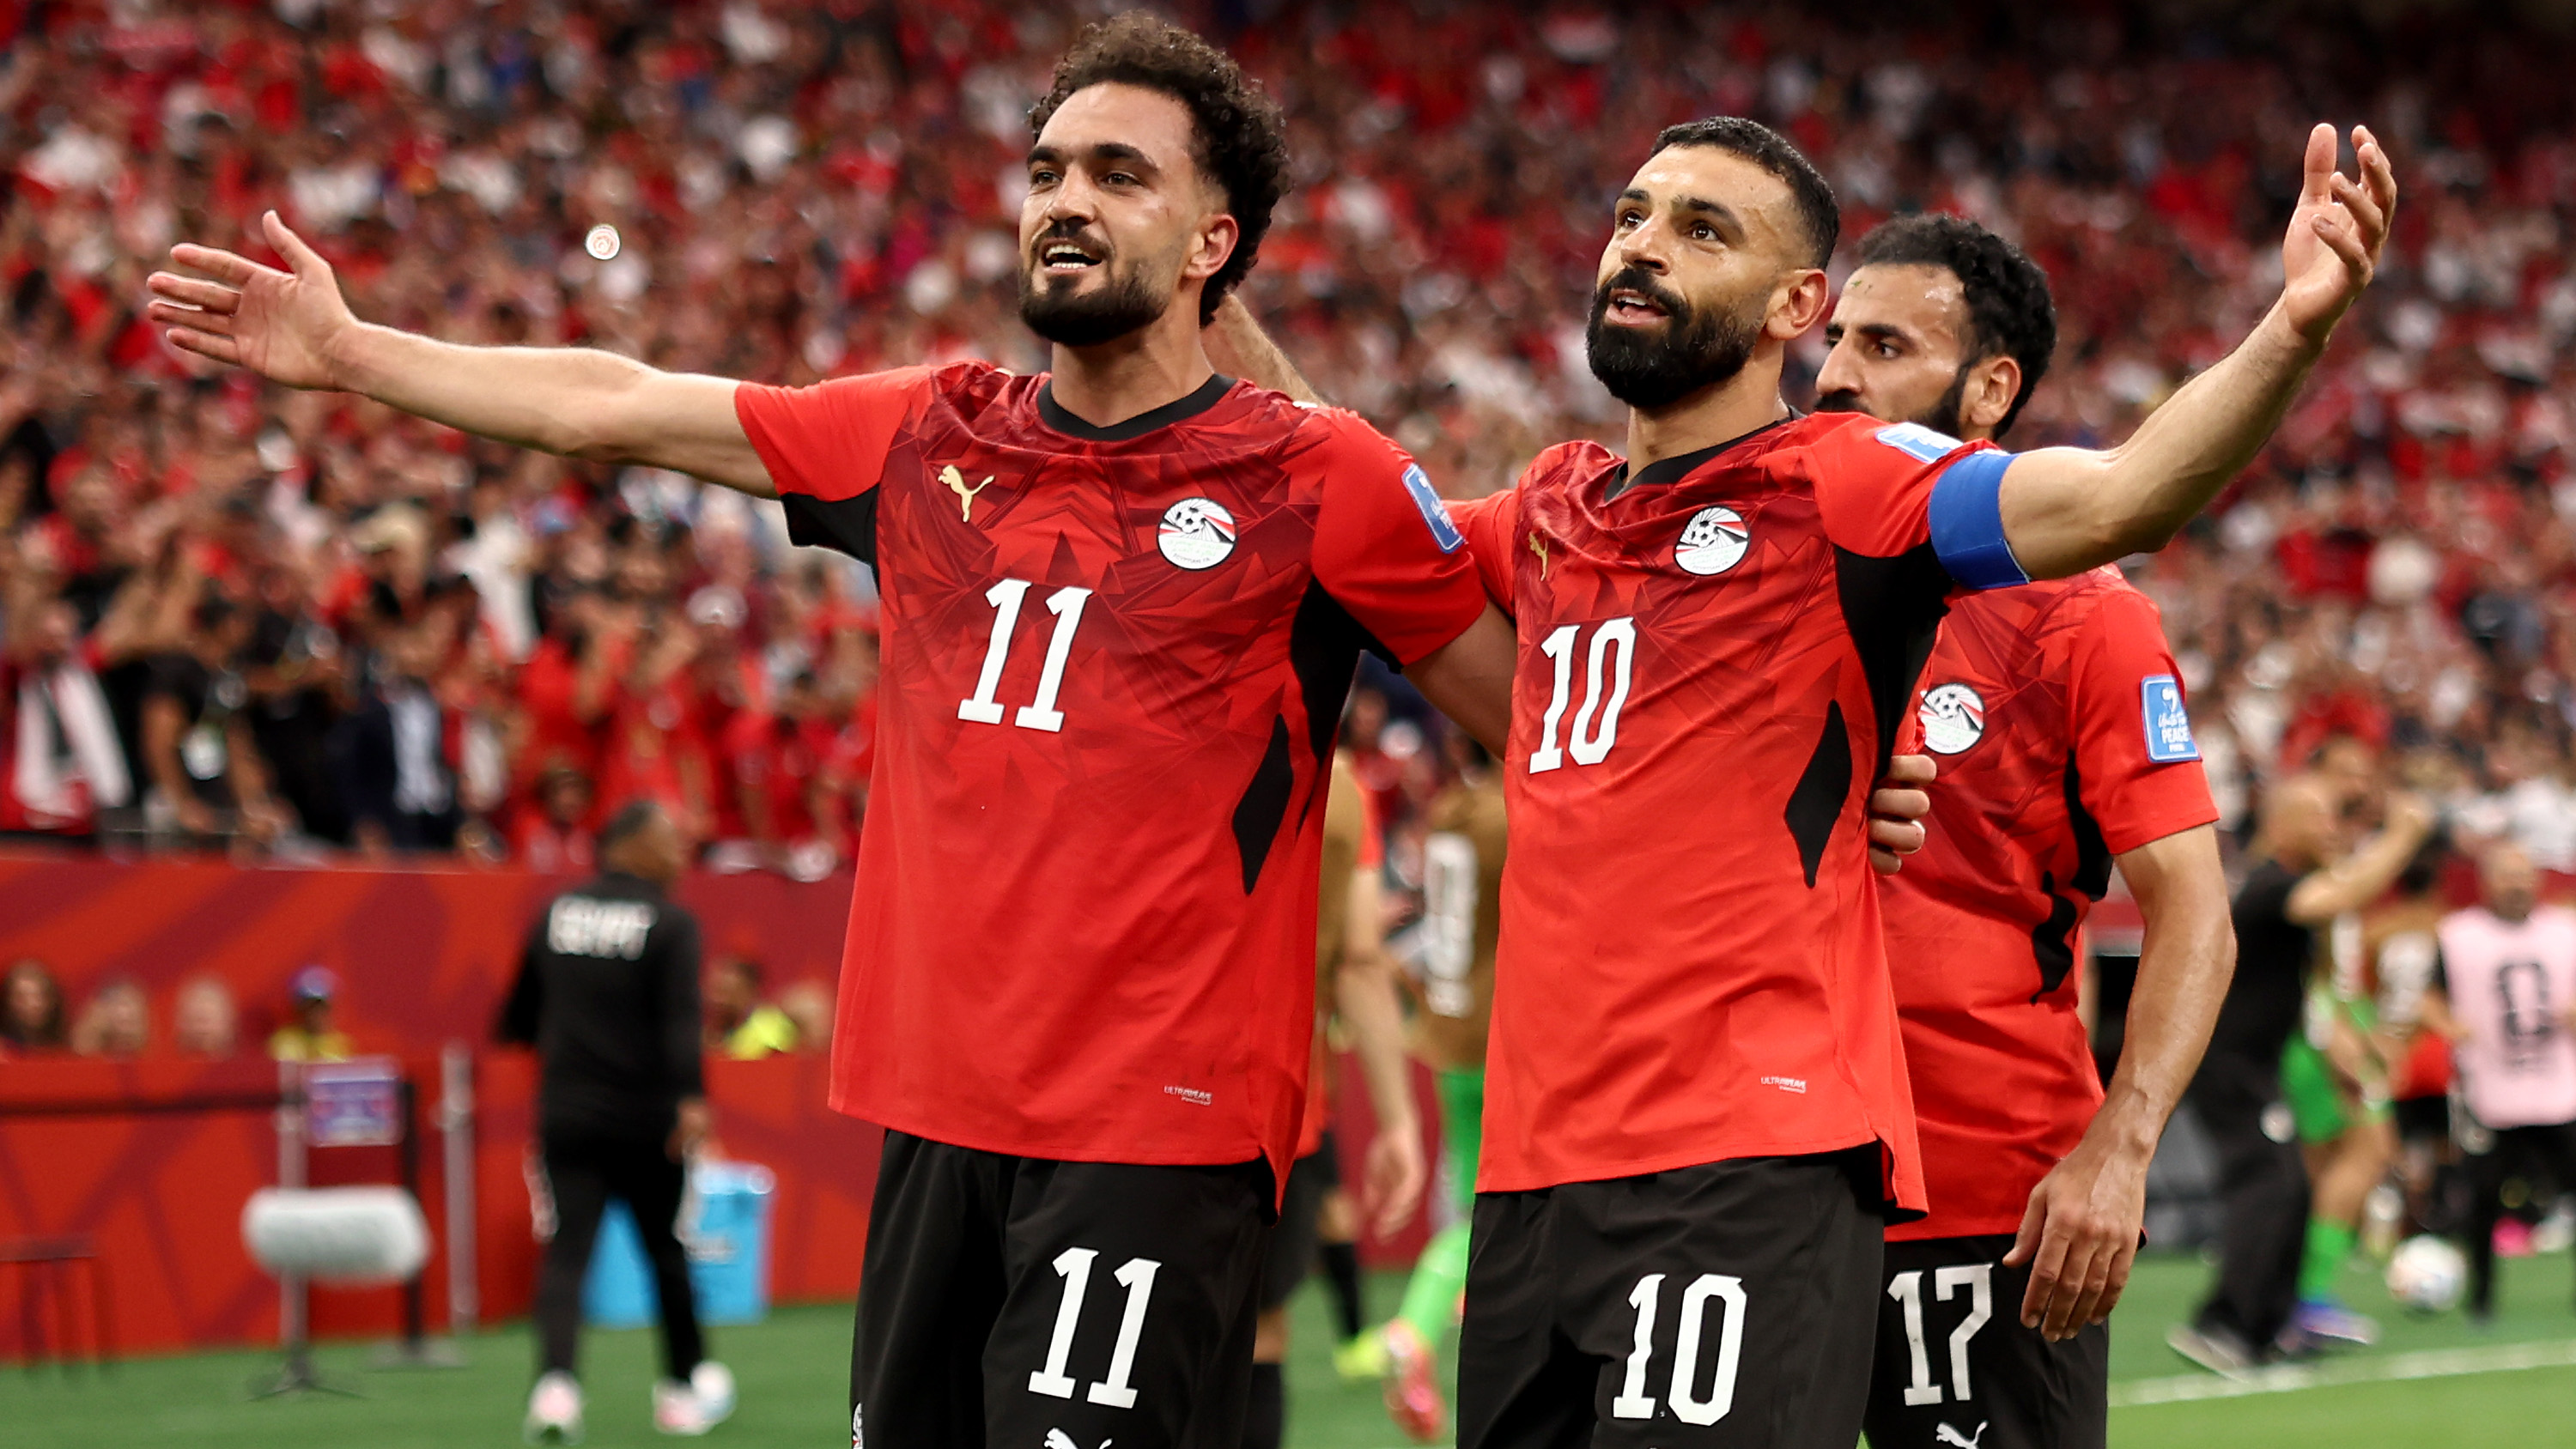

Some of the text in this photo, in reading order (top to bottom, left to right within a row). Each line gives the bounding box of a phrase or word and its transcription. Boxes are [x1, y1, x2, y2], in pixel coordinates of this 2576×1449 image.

[957, 578, 1093, 732] 11
[1528, 616, 1637, 774] 10
[2161, 726, 2190, 744] PEACE
[1028, 1246, 1162, 1409] 11
[1613, 1273, 1747, 1427] 10
[1887, 1263, 1993, 1406] 17
